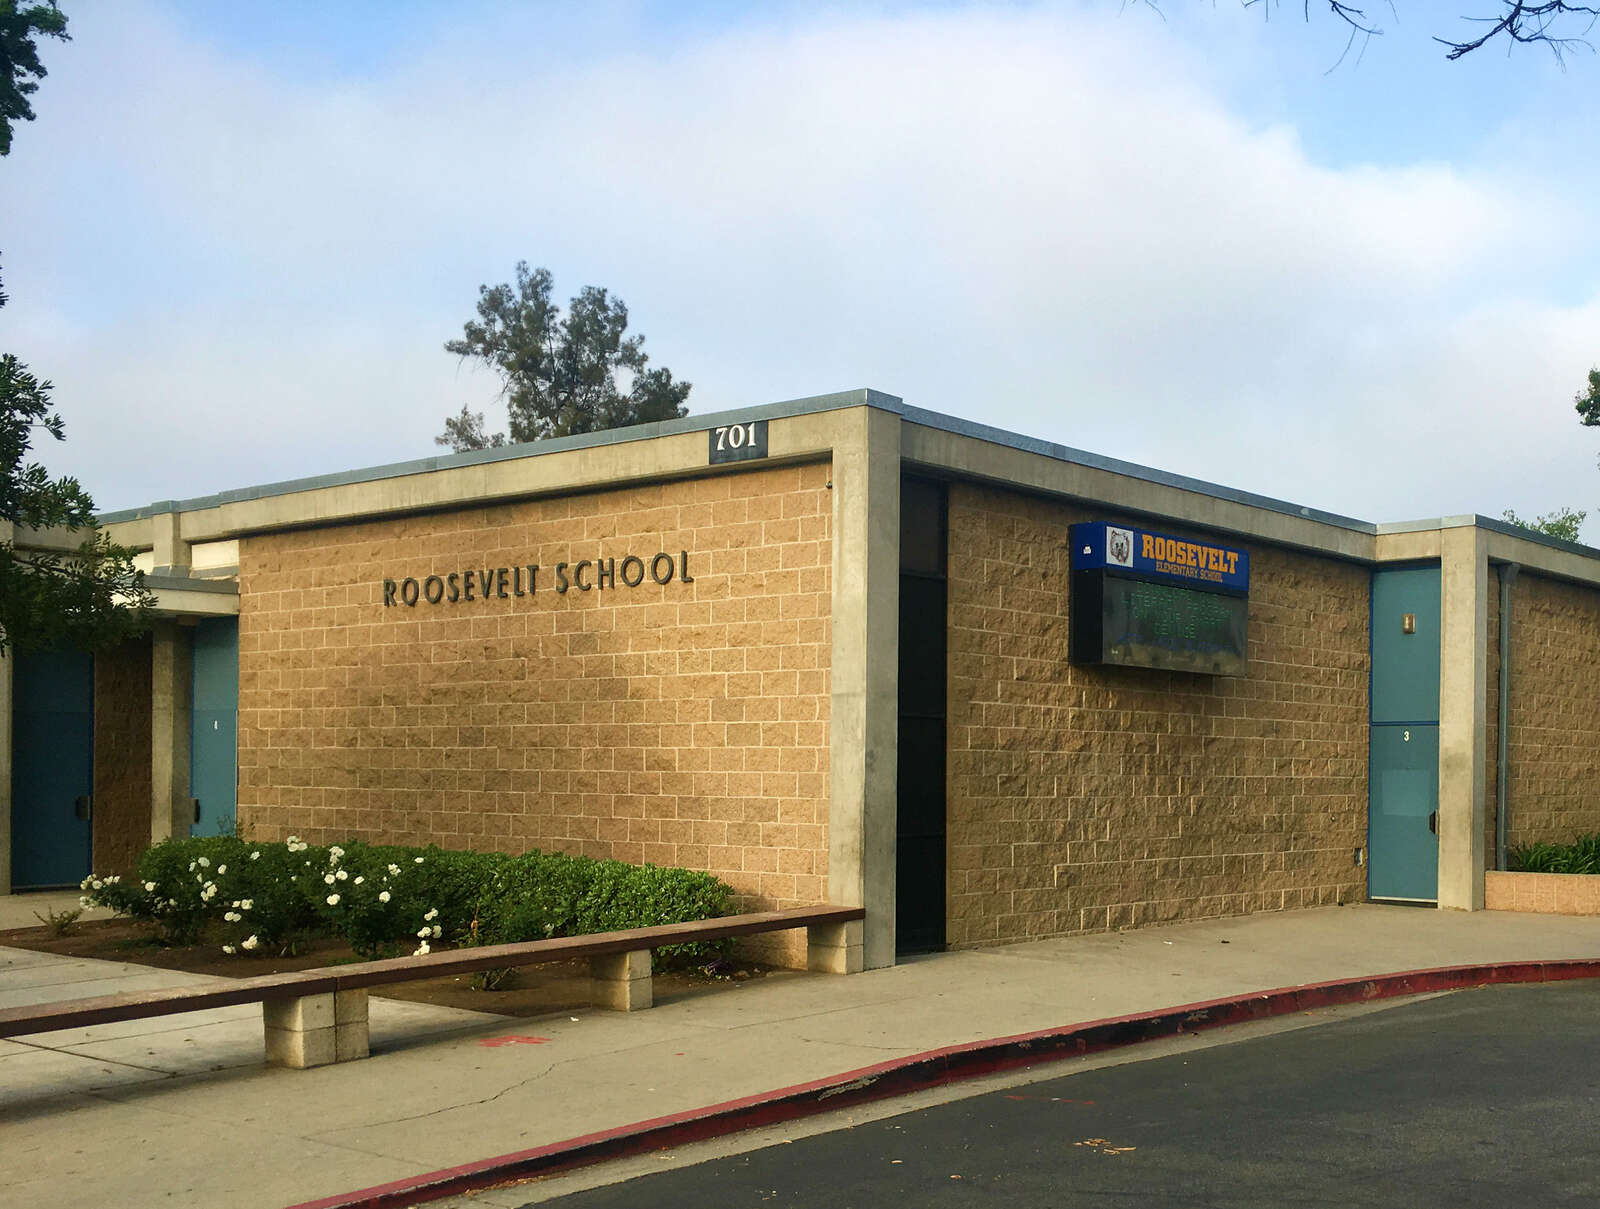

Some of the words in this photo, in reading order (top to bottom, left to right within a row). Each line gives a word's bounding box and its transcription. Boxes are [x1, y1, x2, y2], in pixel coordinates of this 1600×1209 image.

[715, 422, 756, 451] 701
[1142, 534, 1239, 575] ROOSEVELT
[383, 564, 539, 607] ROOSEVELT
[555, 550, 694, 593] SCHOOL
[1155, 561, 1199, 578] ELEMENTARY
[1200, 569, 1224, 583] SCHOOL
[1403, 730, 1410, 742] 3
